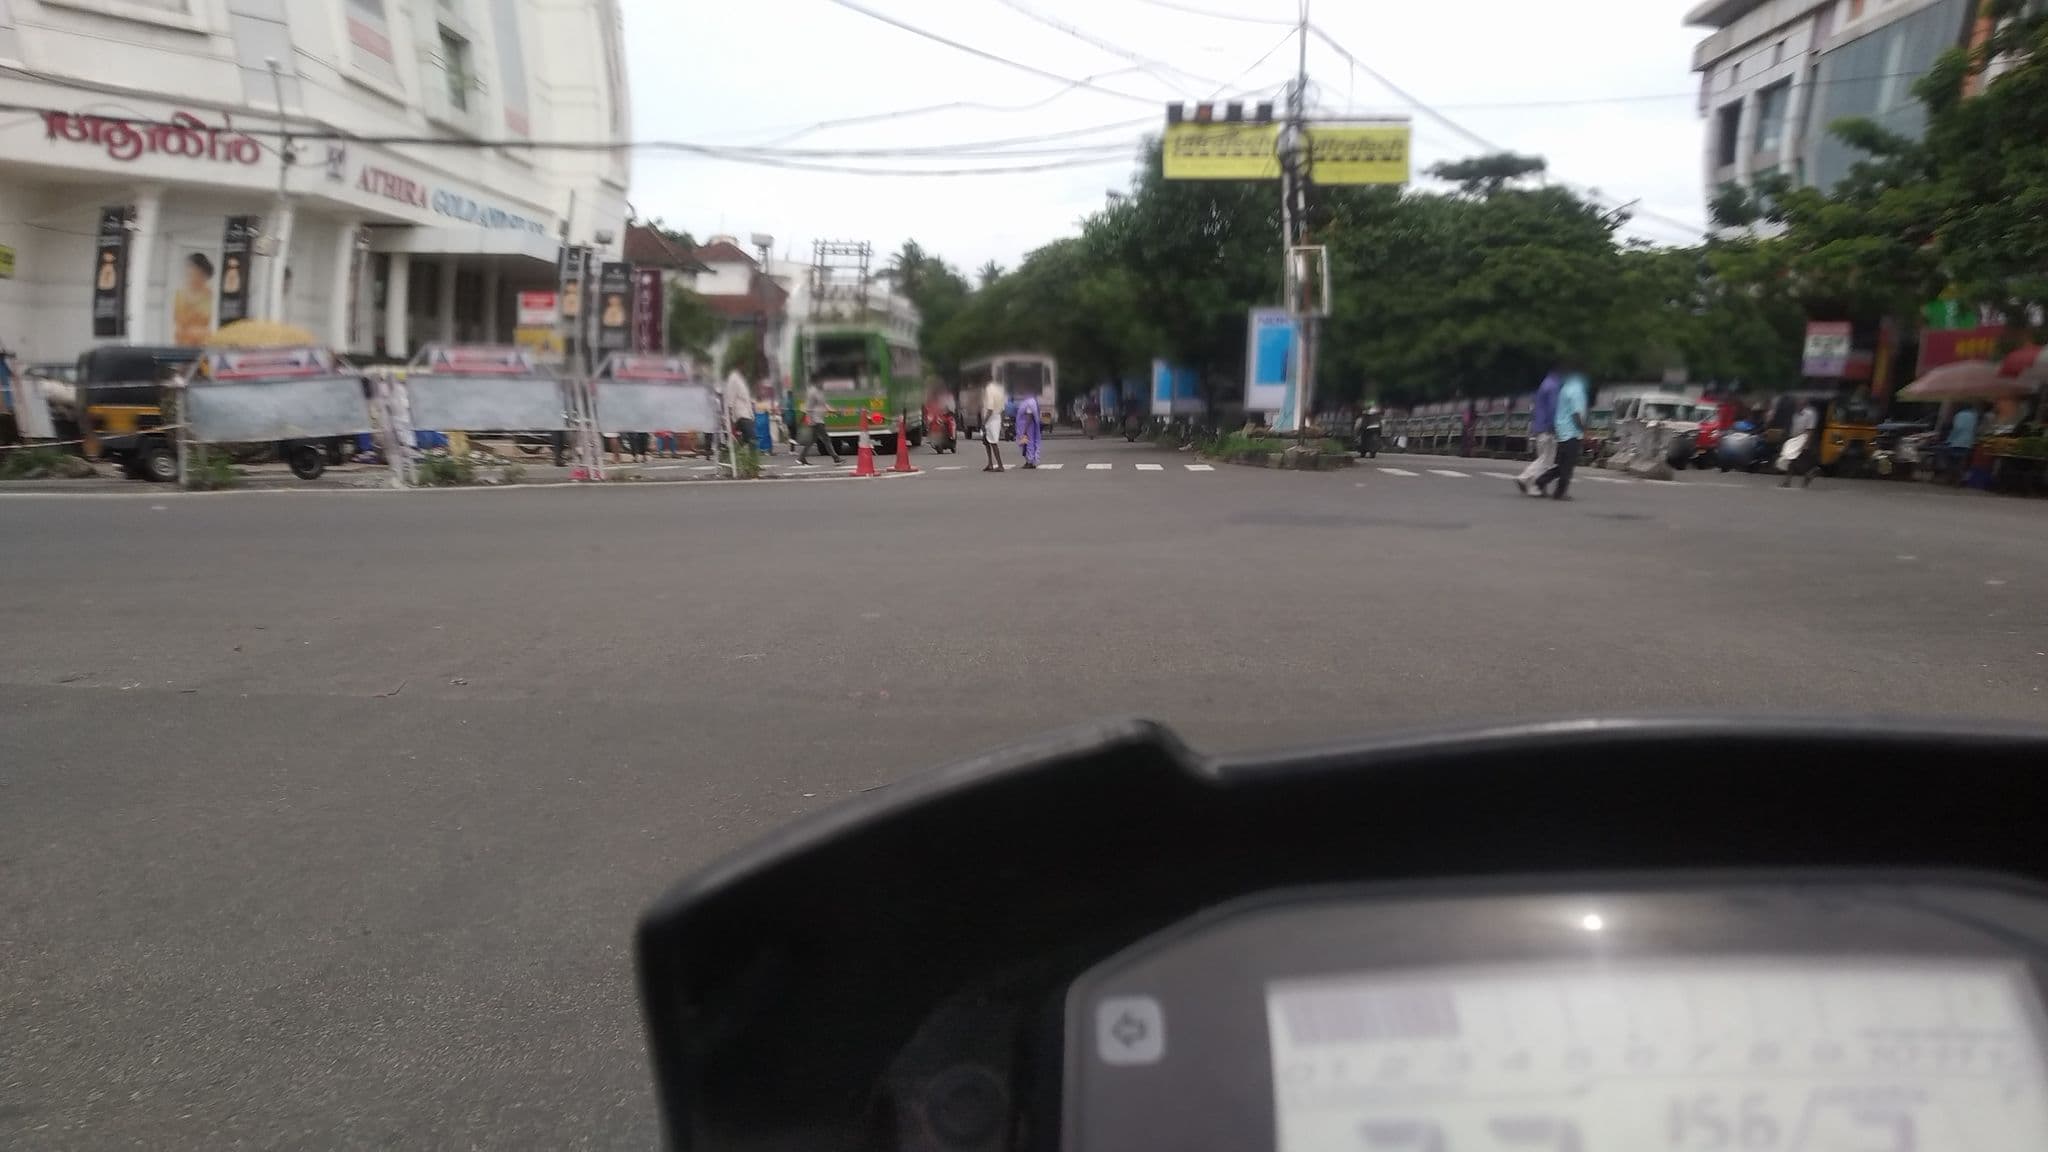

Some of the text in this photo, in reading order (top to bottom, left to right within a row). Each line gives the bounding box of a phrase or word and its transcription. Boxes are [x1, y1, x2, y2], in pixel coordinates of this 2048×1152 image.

[357, 165, 429, 208] ATHIRA
[432, 187, 480, 223] GOLD
[1667, 1091, 1782, 1150] 156
